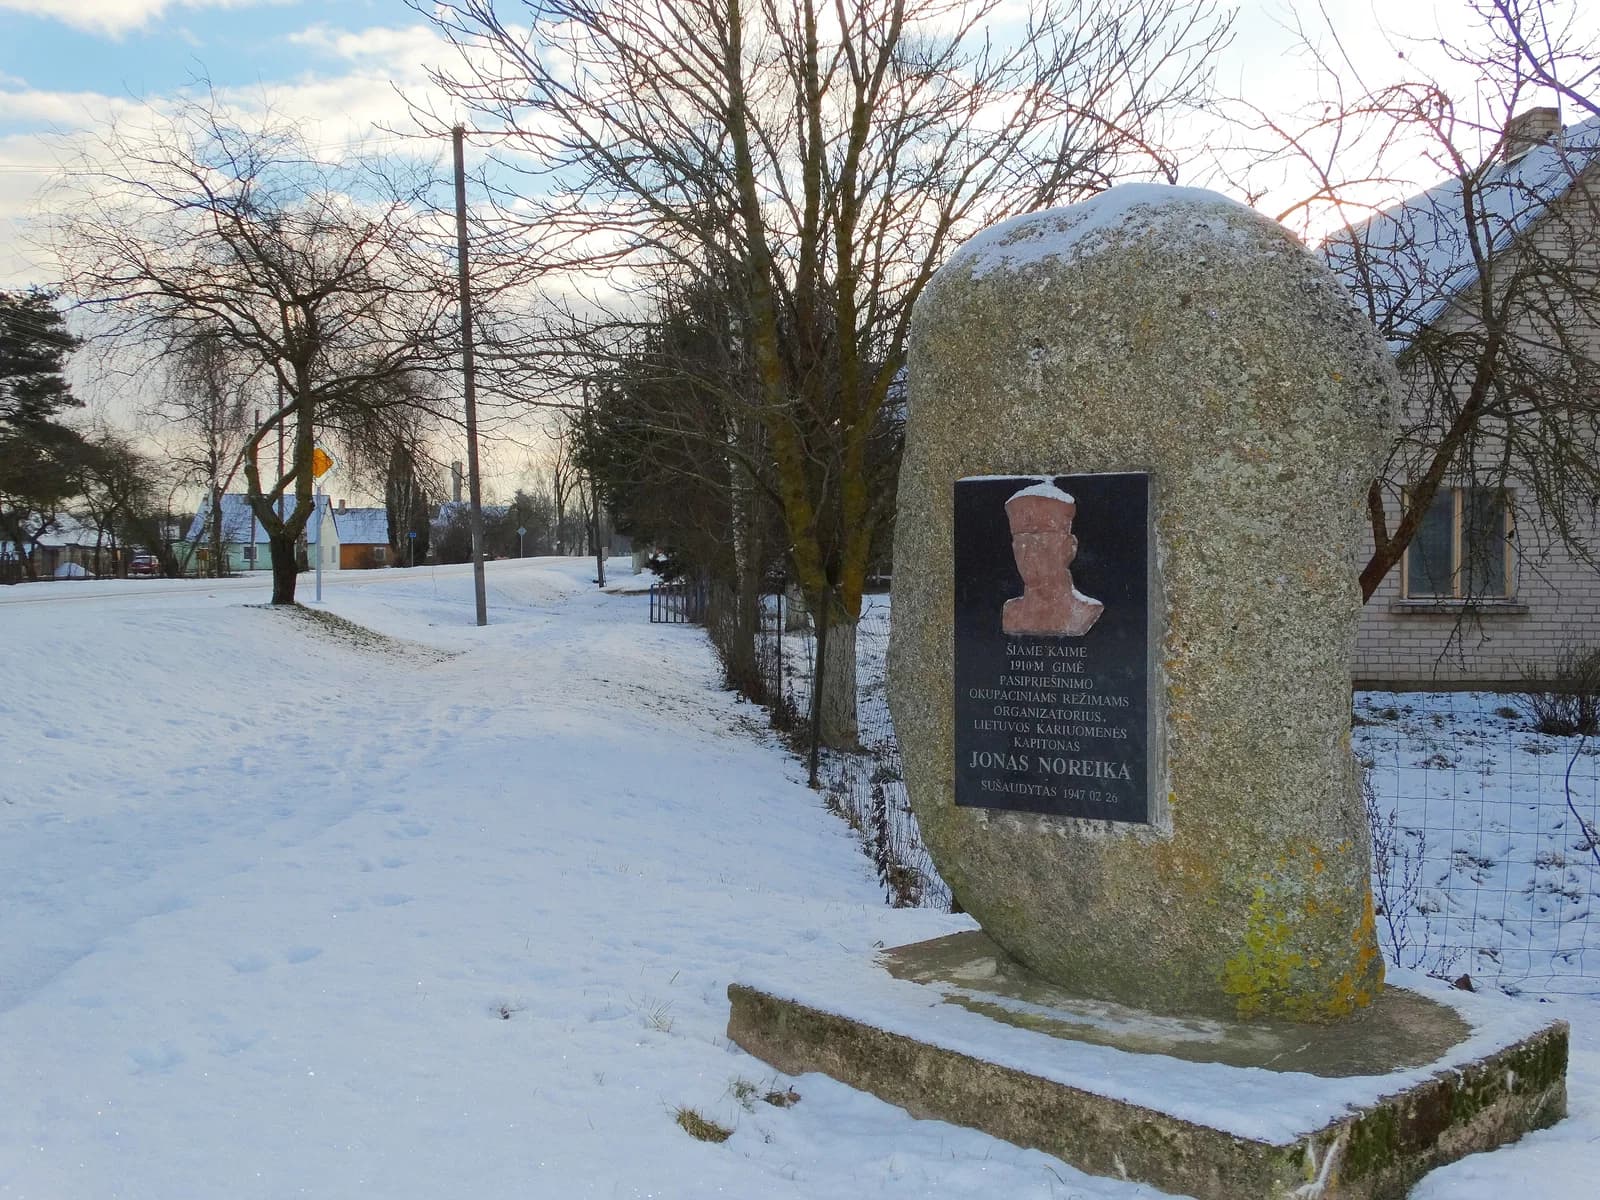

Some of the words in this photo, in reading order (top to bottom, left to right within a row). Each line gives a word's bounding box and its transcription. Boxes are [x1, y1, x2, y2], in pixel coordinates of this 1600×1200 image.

[1006, 643, 1043, 656] ŠIAME
[1048, 646, 1087, 658] KAIME
[1000, 674, 1093, 689] PASIPRIEŠINIMO
[969, 688, 1057, 703] OKUPACINIAMS
[1063, 692, 1129, 707] REŽIMAMS
[974, 719, 1030, 733] LIETUVOS
[1036, 723, 1127, 739] KARIUOMENĖS
[1014, 737, 1080, 752] KAPITONAS
[970, 751, 1029, 772] JONAS
[1039, 757, 1132, 780] NOREIKA
[981, 779, 1057, 797] SUŠAUDYTAS
[1063, 788, 1084, 800] 1947
[1089, 790, 1101, 802] 02
[1105, 792, 1118, 804] 26
